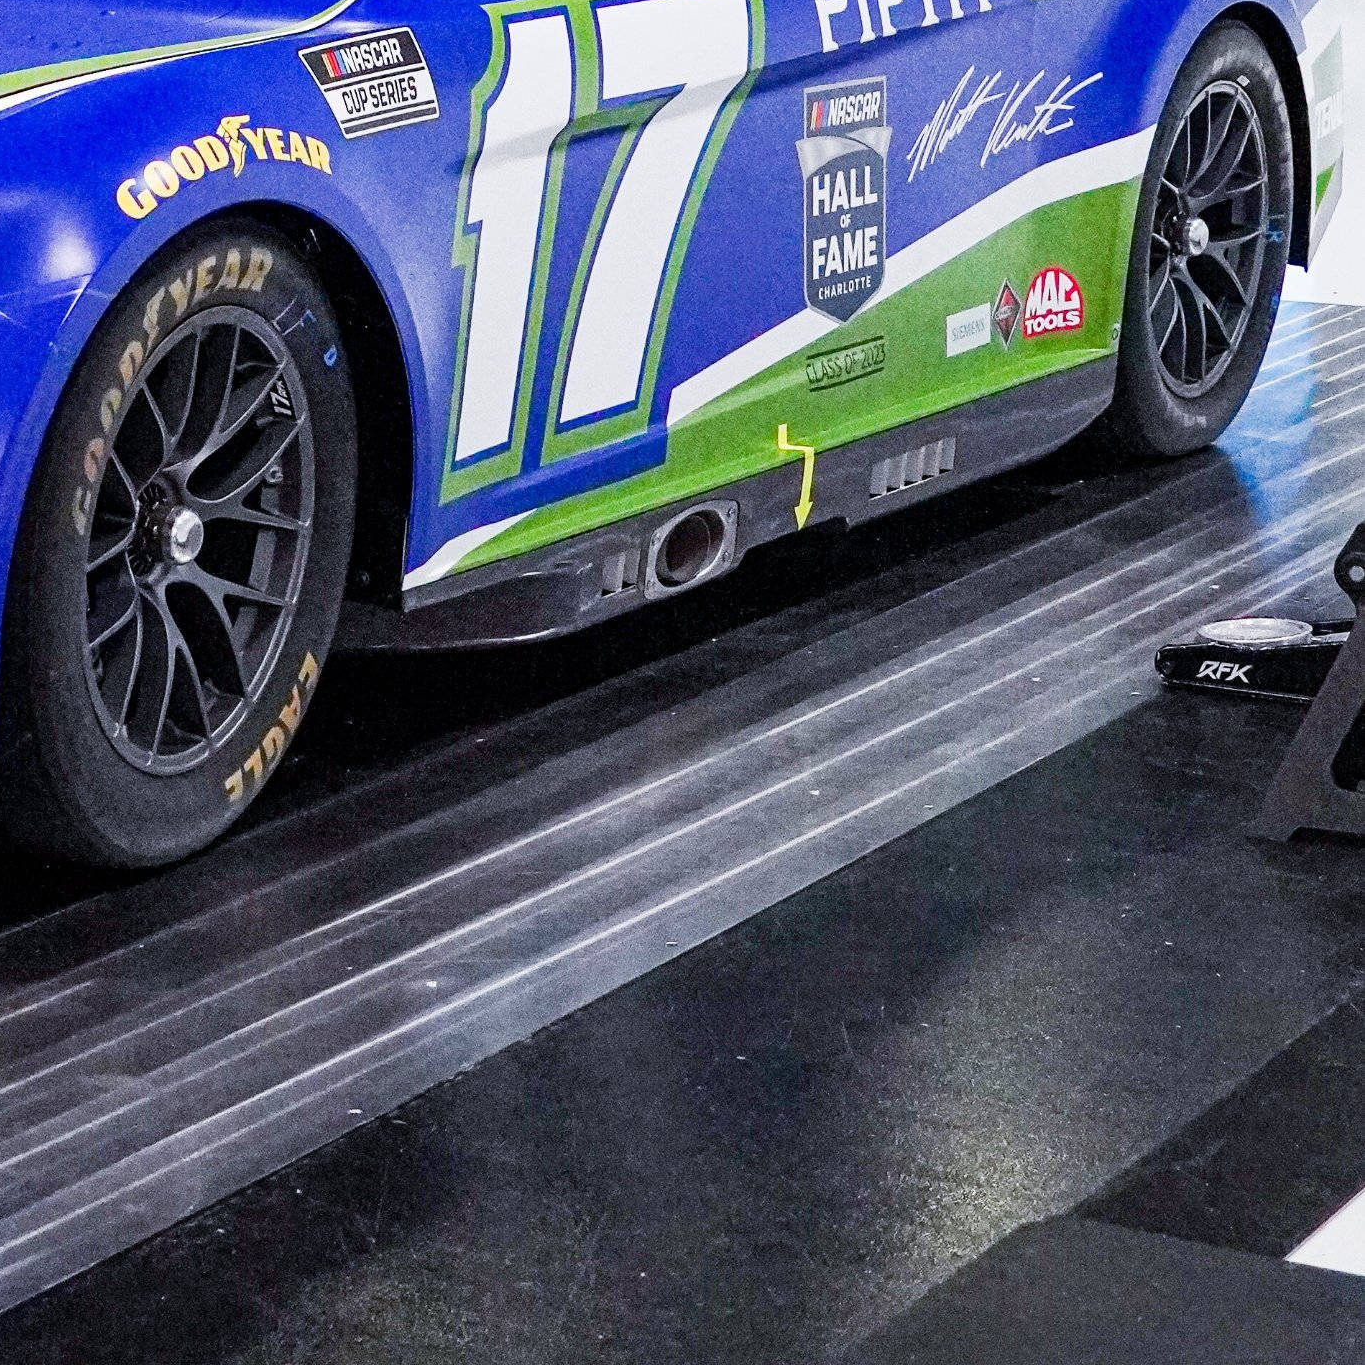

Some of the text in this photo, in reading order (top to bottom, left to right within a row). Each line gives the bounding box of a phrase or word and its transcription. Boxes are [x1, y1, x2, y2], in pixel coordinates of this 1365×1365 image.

[339, 36, 405, 74] NASCAR
[341, 75, 418, 115] CUP SERIES
[825, 91, 882, 127] NASCAR
[811, 165, 879, 217] HALL
[839, 213, 852, 229] OF
[811, 226, 879, 281] FAME
[818, 275, 872, 301] CHARLOTTE
[1025, 270, 1081, 319] MAC
[1024, 310, 1081, 335] TOOLS
[805, 356, 843, 385] CLASS
[860, 342, 886, 370] 2023
[1196, 660, 1253, 684] RFK
